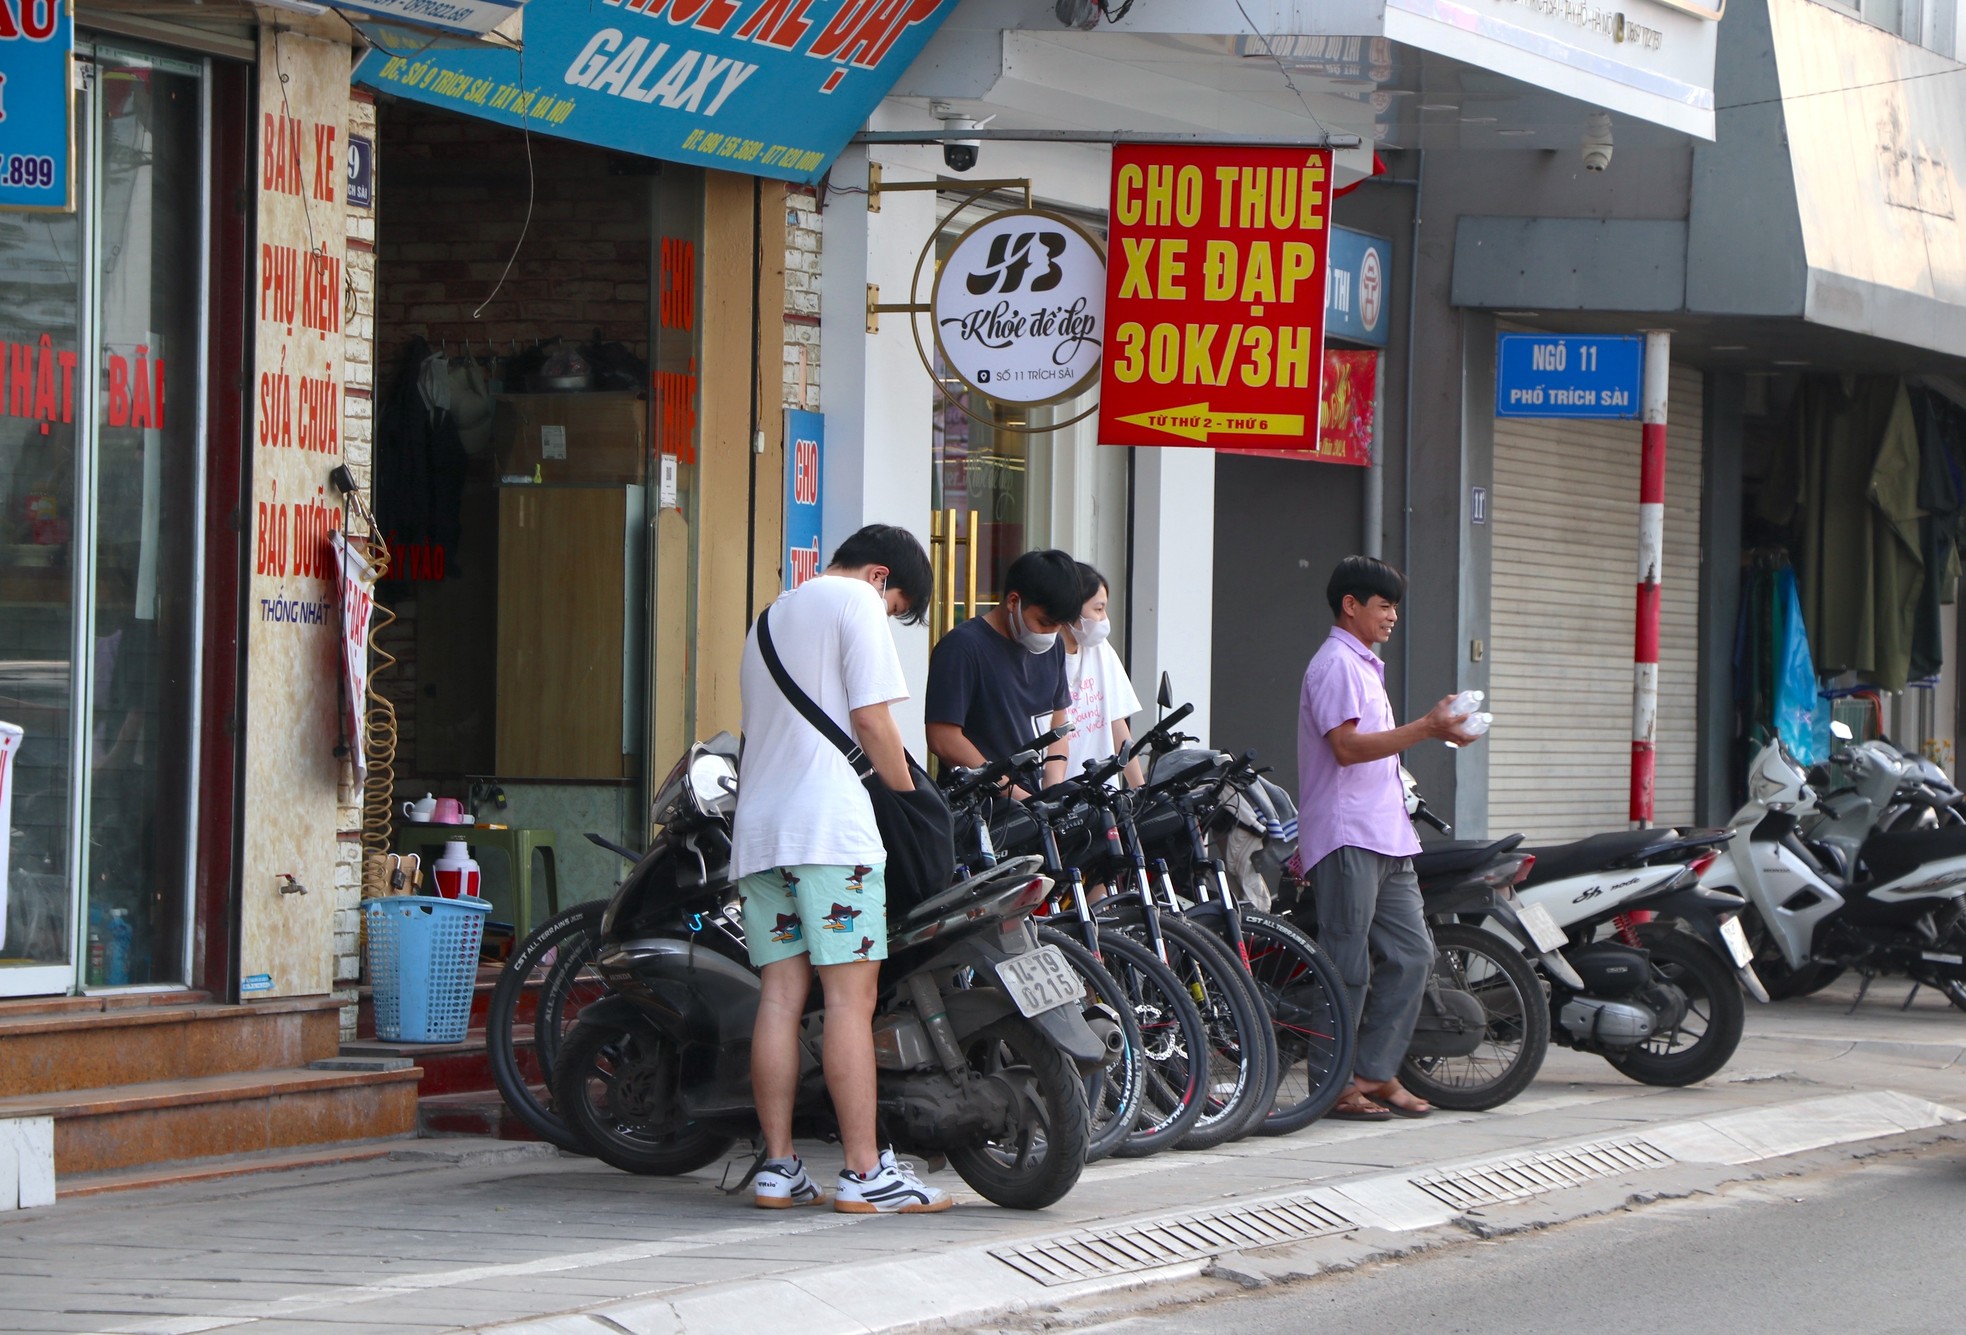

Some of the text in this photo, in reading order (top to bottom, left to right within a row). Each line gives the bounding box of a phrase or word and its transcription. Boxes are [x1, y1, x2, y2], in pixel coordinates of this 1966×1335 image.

[402, 57, 437, 86] SỐ
[420, 67, 438, 89] 9
[429, 69, 473, 97] TRÍCH
[464, 76, 494, 108] SÀI,
[488, 82, 518, 110] TÂY
[529, 93, 557, 120] HÀ
[546, 97, 576, 127] NỘI
[564, 28, 759, 117] GALAXY
[263, 101, 336, 203] BÁN XE
[347, 144, 360, 180] 9
[356, 184, 368, 200] SÀI
[1116, 154, 1326, 230] CHO THUÊ
[261, 240, 341, 342] PHỤ KIỆN
[660, 235, 696, 333] CHO
[1117, 237, 1316, 317] XE ĐẠP
[1334, 269, 1351, 323] THỊ
[940, 296, 1102, 366] Khỏe để đẹp
[1113, 321, 1312, 389] 30K/3H
[1532, 340, 1598, 372] NGÕ 11
[259, 343, 338, 456] SỬA CHỮA
[996, 366, 1075, 382] SỐ 11 TRÍCH SÀI
[1510, 384, 1629, 407] PHỐ TRÍCH SÀI
[1148, 414, 1168, 427] TỪ
[1170, 415, 1200, 428] THỨ
[1203, 417, 1212, 429] 2
[1226, 416, 1257, 430] THỨ
[1259, 419, 1269, 430] 6
[794, 438, 819, 506] CHO
[257, 479, 288, 578] BẢO
[409, 535, 446, 582] VÀO
[261, 585, 299, 624] THỐNG
[301, 594, 331, 627] NHẤT
[513, 952, 528, 972] CST
[526, 941, 540, 956] ALL
[536, 917, 571, 944] TERRAINS
[1262, 919, 1276, 929] ALL
[1021, 973, 1075, 1010] 0215
[1132, 1047, 1142, 1070] ALL
